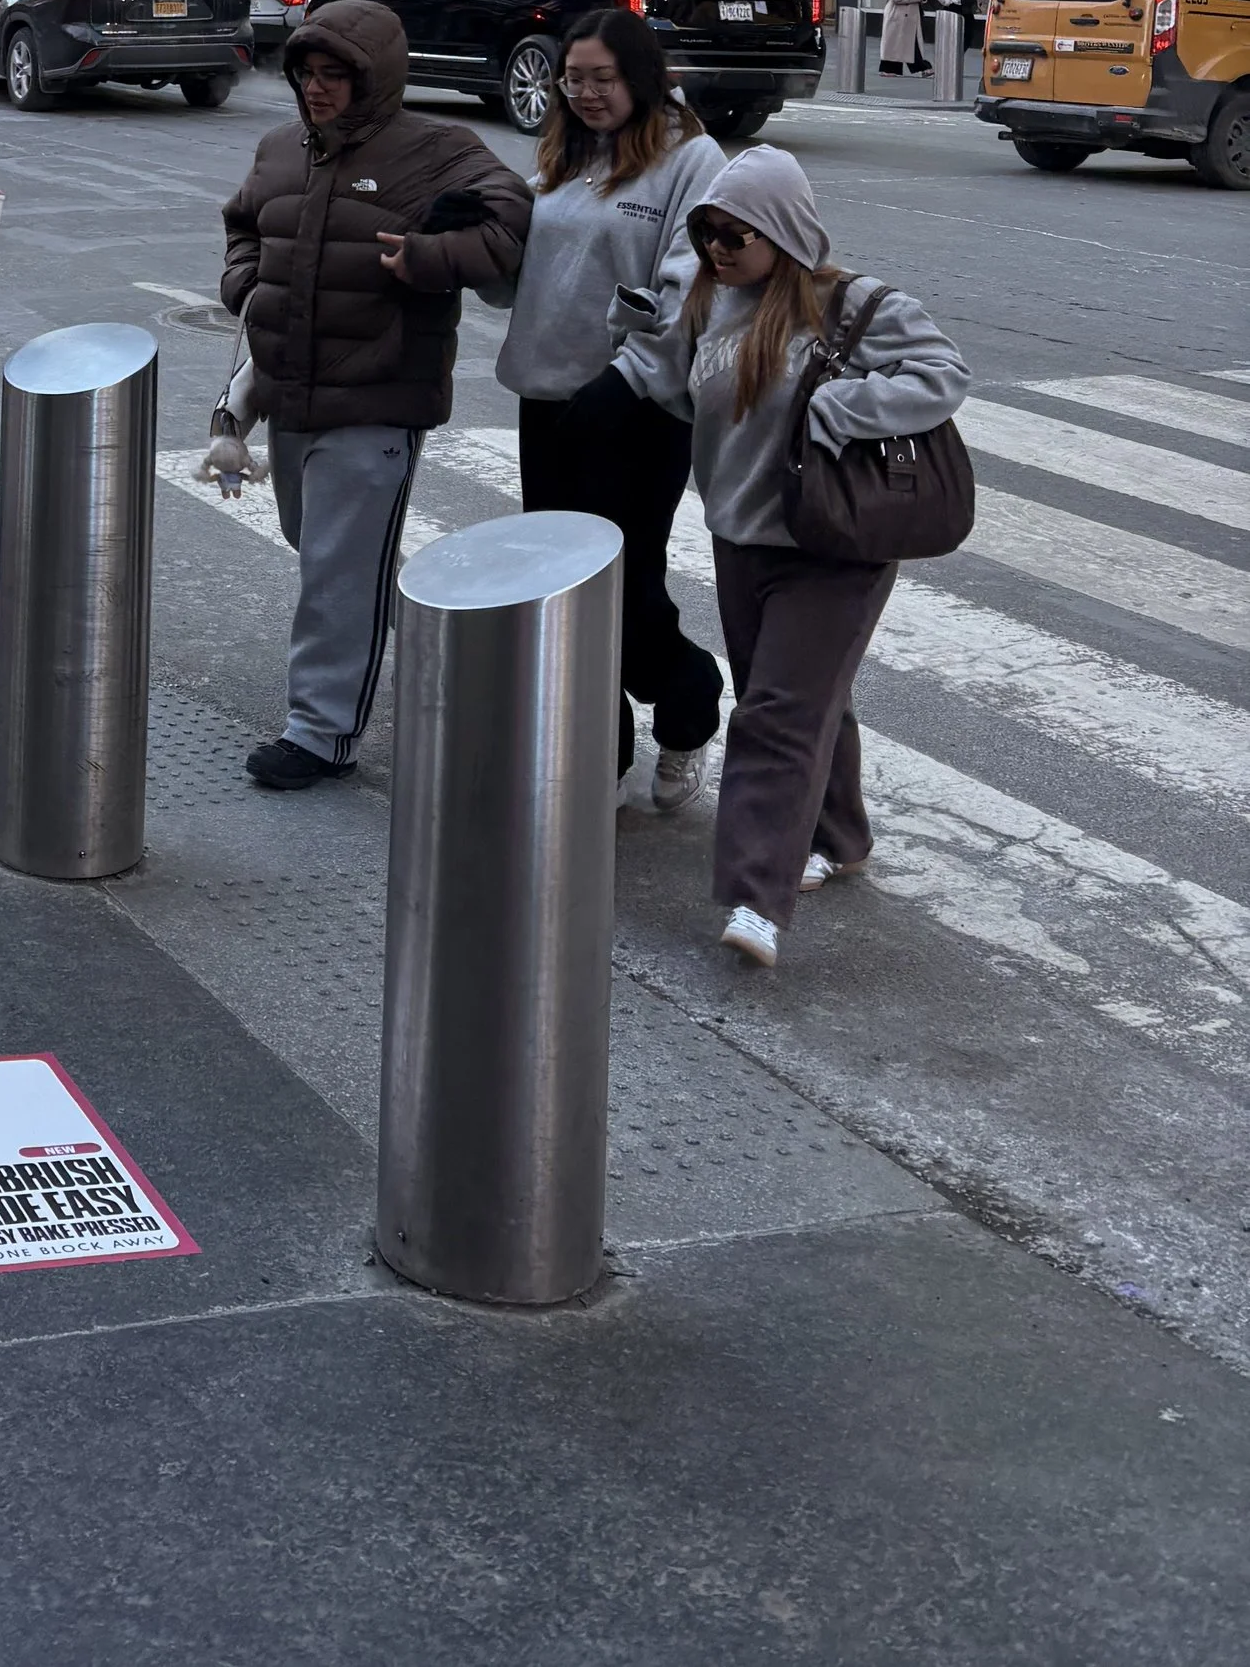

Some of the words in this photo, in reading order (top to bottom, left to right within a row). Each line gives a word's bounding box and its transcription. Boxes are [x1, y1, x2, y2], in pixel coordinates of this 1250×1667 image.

[44, 1145, 76, 1156] NEW
[42, 1185, 142, 1222] EASY
[17, 1223, 77, 1243] BAKE
[75, 1216, 160, 1238] PRESSED
[40, 1240, 104, 1256] BLOCK
[113, 1235, 165, 1249] AWAY
